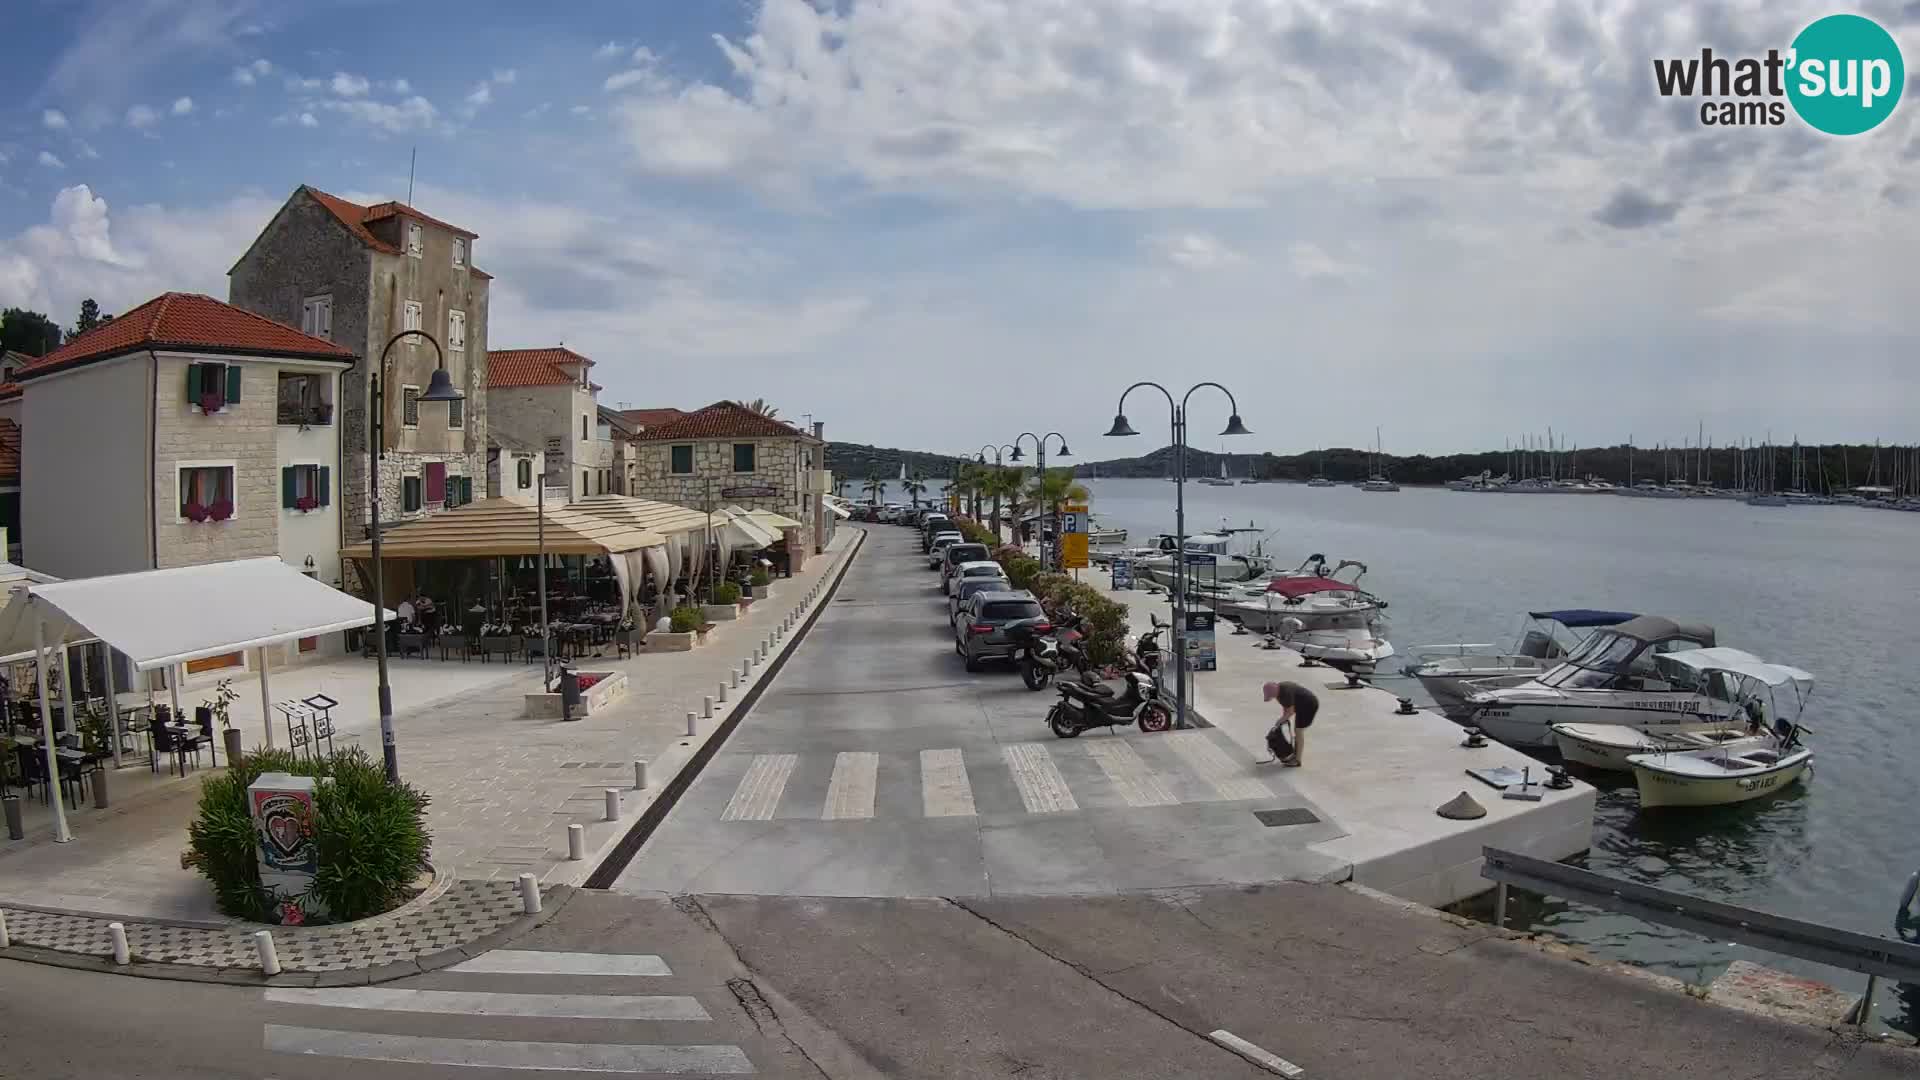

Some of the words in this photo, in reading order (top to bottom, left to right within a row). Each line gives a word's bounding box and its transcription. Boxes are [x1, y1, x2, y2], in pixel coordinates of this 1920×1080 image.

[1065, 515, 1075, 531] P
[1658, 701, 1676, 711] RENT
[1683, 701, 1700, 712] BOAT
